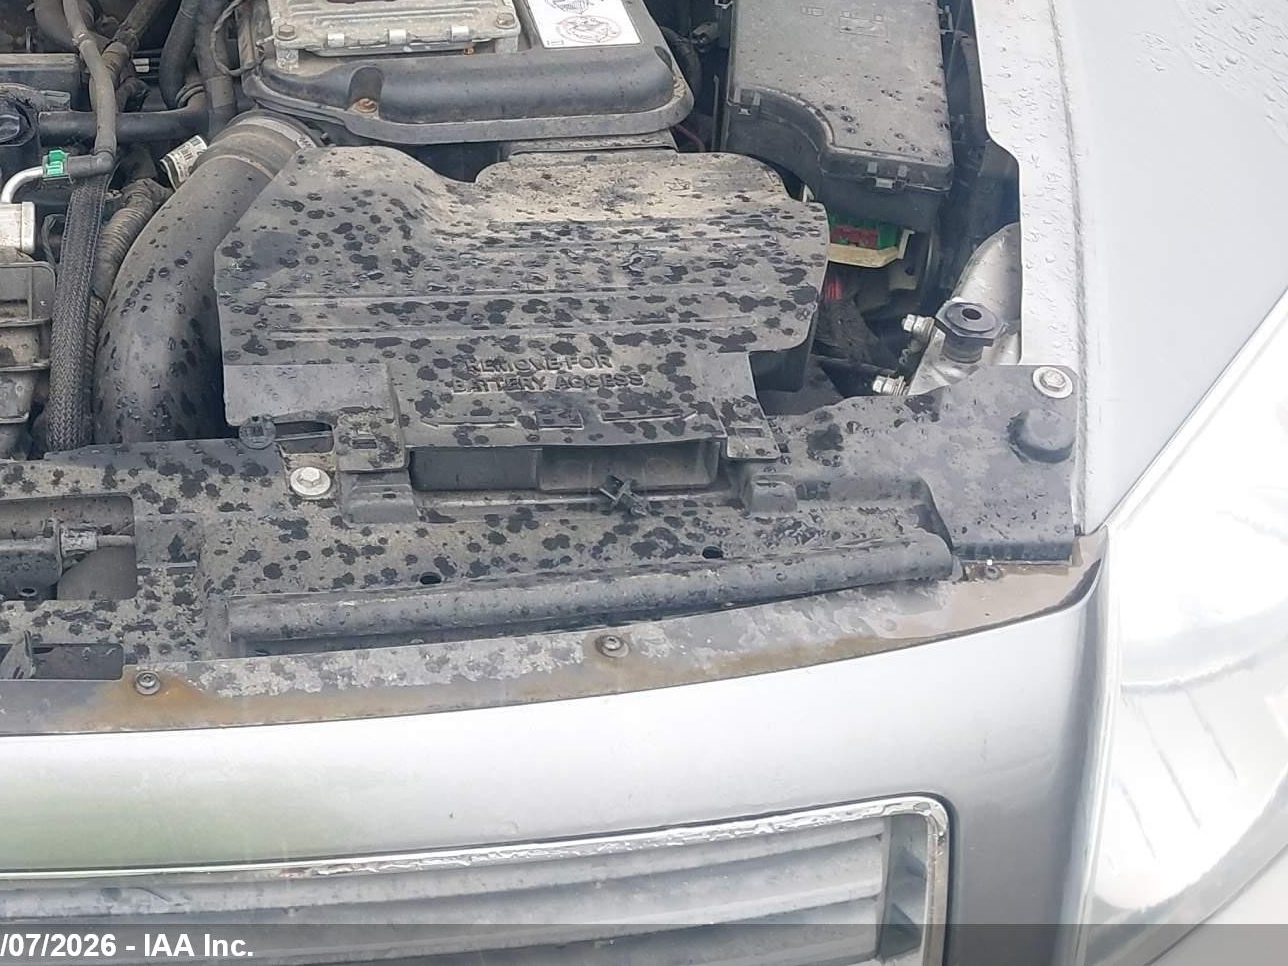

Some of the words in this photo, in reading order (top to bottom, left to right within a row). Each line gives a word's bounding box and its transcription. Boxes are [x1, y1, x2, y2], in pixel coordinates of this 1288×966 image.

[464, 356, 562, 375] REMOVE
[563, 354, 614, 371] FOR
[451, 375, 547, 394] BATTERY
[554, 371, 644, 390] ACCESS
